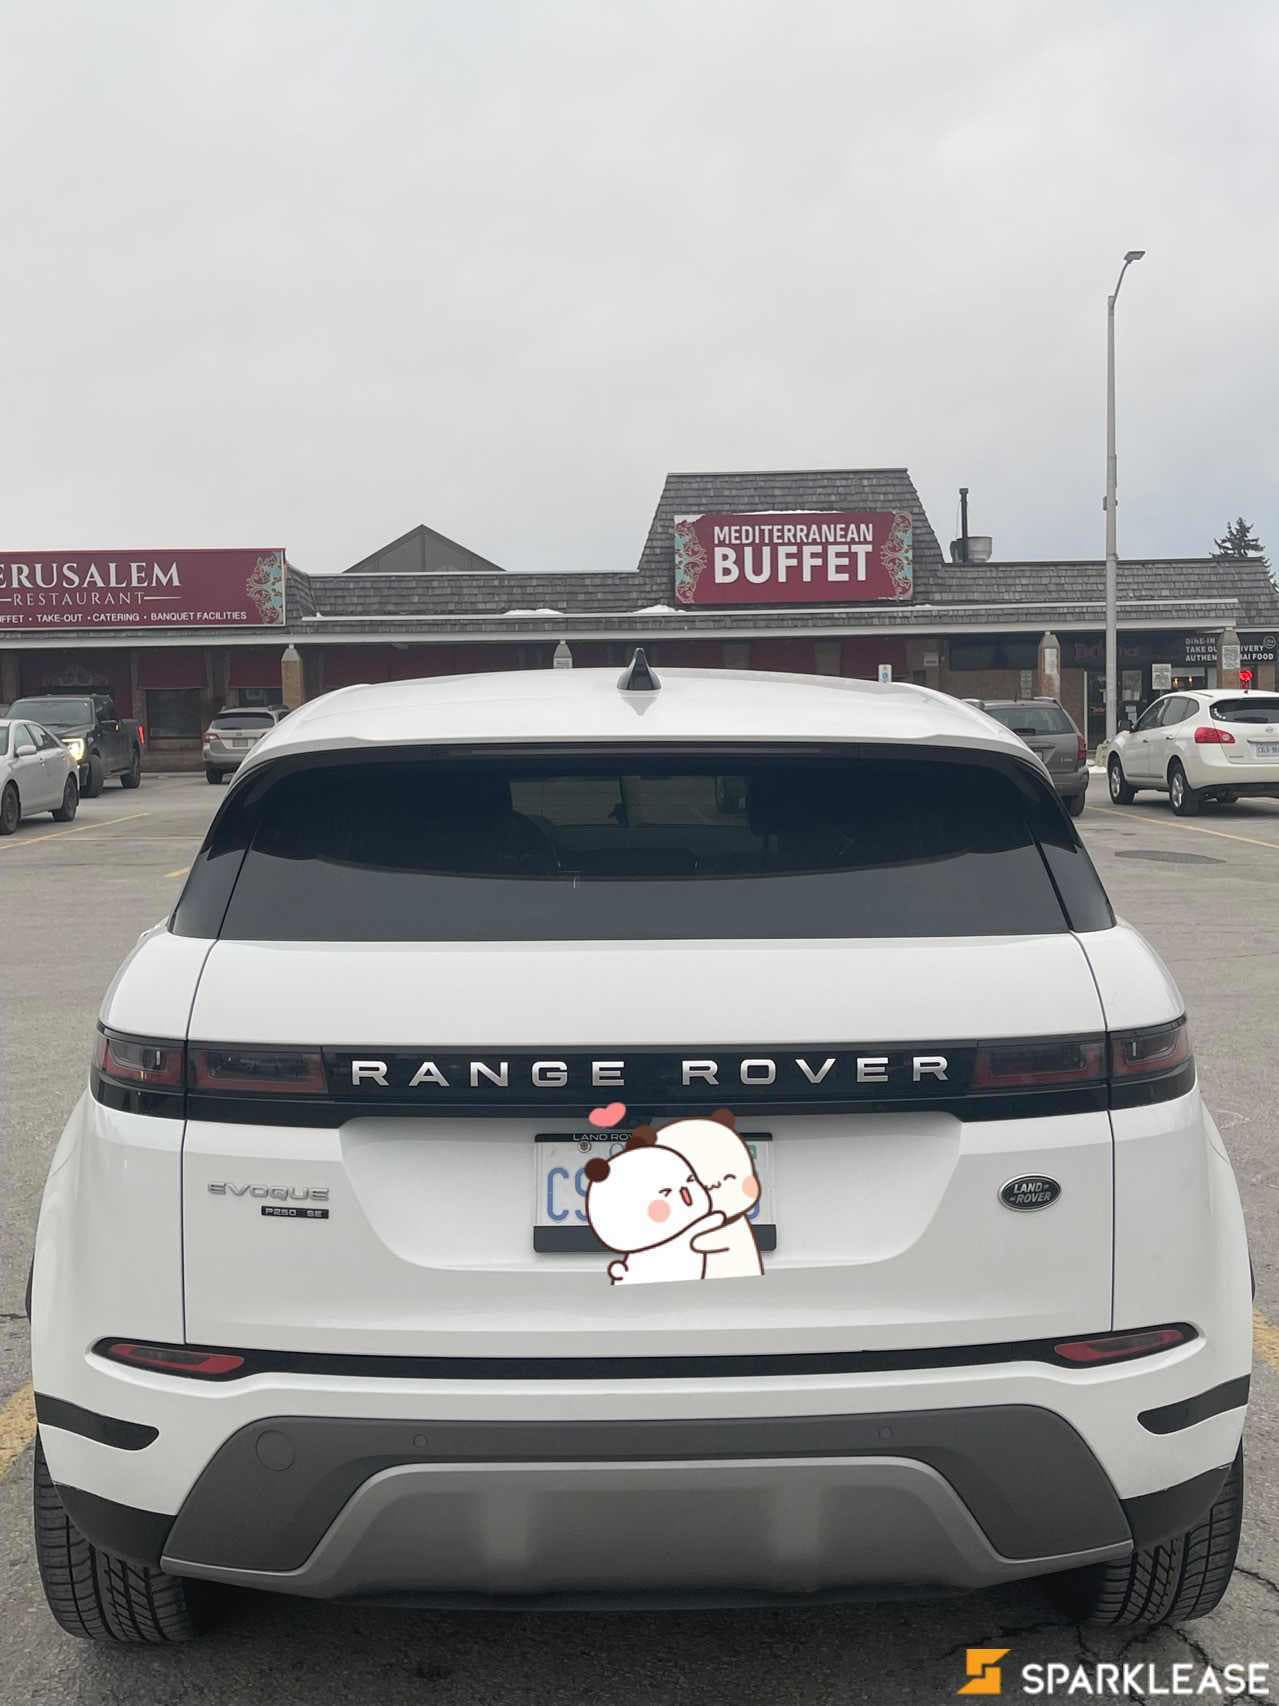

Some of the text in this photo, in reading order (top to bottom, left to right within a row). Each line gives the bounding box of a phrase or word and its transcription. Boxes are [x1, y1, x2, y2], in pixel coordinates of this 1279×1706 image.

[713, 523, 873, 545] MEDITERRANEAN
[713, 544, 873, 584] BUFFET
[13, 591, 144, 606] RESTAURANT
[0, 611, 247, 624] FFET TAKE-OUT CATERING BANQUET FACILITIES
[1185, 654, 1218, 662] AUTHEN
[352, 1056, 949, 1088] RANGE ROVER
[572, 1133, 608, 1141] LAND
[208, 1182, 329, 1201] EVOQUE
[265, 1207, 297, 1216] P250
